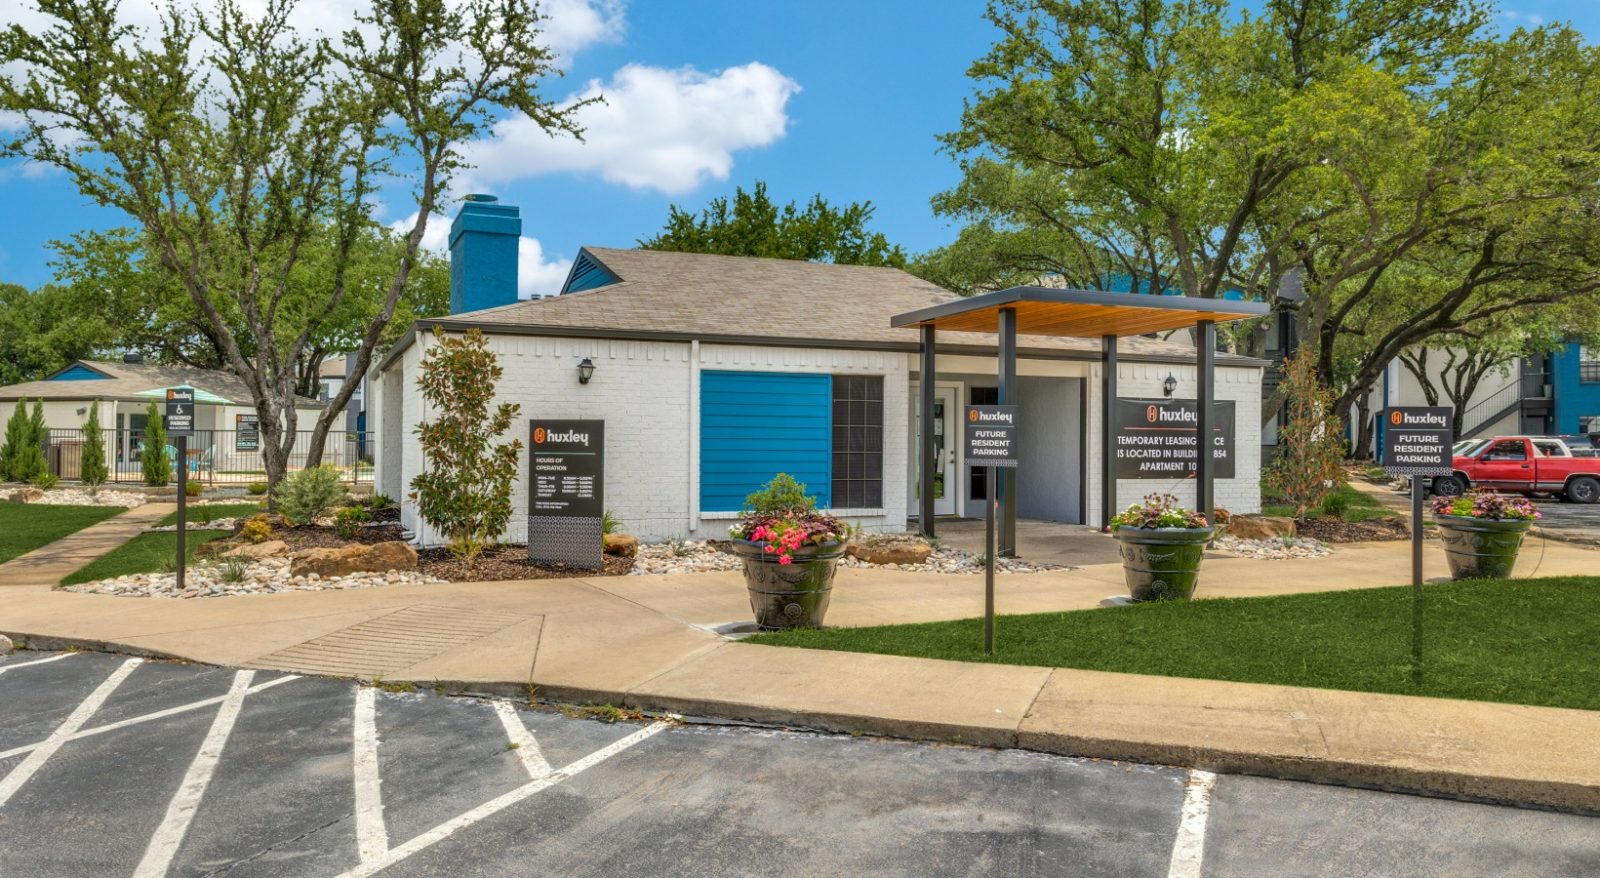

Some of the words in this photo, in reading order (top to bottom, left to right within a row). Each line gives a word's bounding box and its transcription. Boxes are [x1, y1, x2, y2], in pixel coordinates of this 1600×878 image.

[979, 410, 1013, 424] huxley
[1404, 412, 1446, 427] huxley
[547, 429, 589, 447] huxley
[975, 430, 1007, 438] FUTURE
[971, 439, 1011, 447] RESIDENT
[1117, 436, 1164, 445] TEMPORARY
[1165, 436, 1197, 445] LEASING
[1399, 435, 1439, 443] FUTURE
[973, 448, 1009, 456] PARKING
[1393, 445, 1444, 453] RESIDENT
[1117, 449, 1124, 458] IS
[1126, 449, 1161, 458] LOCATED
[1163, 449, 1172, 458] IN
[1173, 449, 1198, 458] BUILDI
[1396, 455, 1442, 463] PARKING
[1139, 462, 1184, 471] APARTMENT
[1188, 462, 1197, 471] 10
